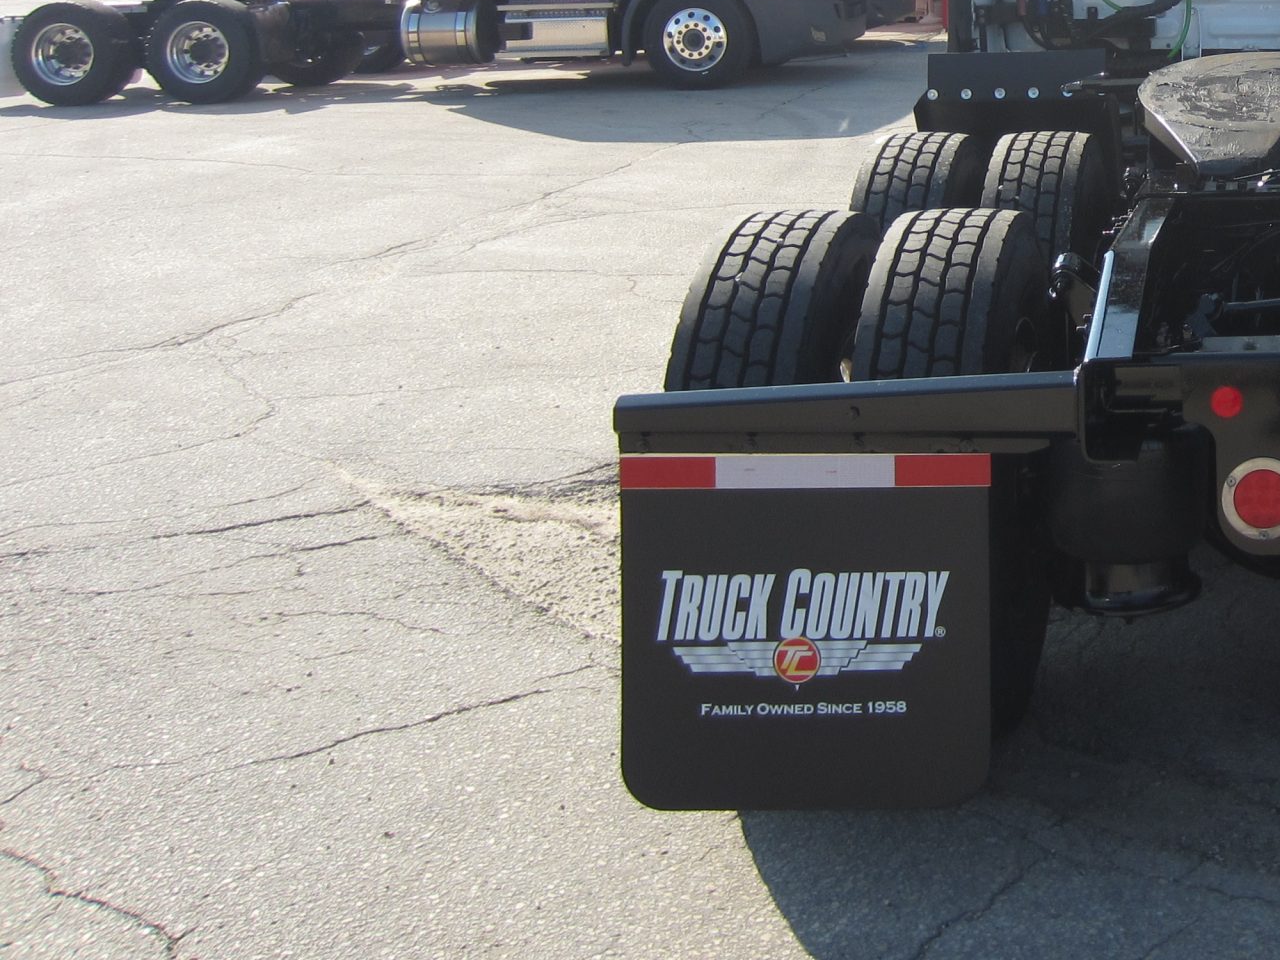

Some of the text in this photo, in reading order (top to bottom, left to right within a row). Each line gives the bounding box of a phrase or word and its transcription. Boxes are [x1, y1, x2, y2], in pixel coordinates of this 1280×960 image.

[657, 568, 950, 641] TRUCK COUNTRY
[700, 700, 907, 716] FAMILY OWNED SINCE 1958
